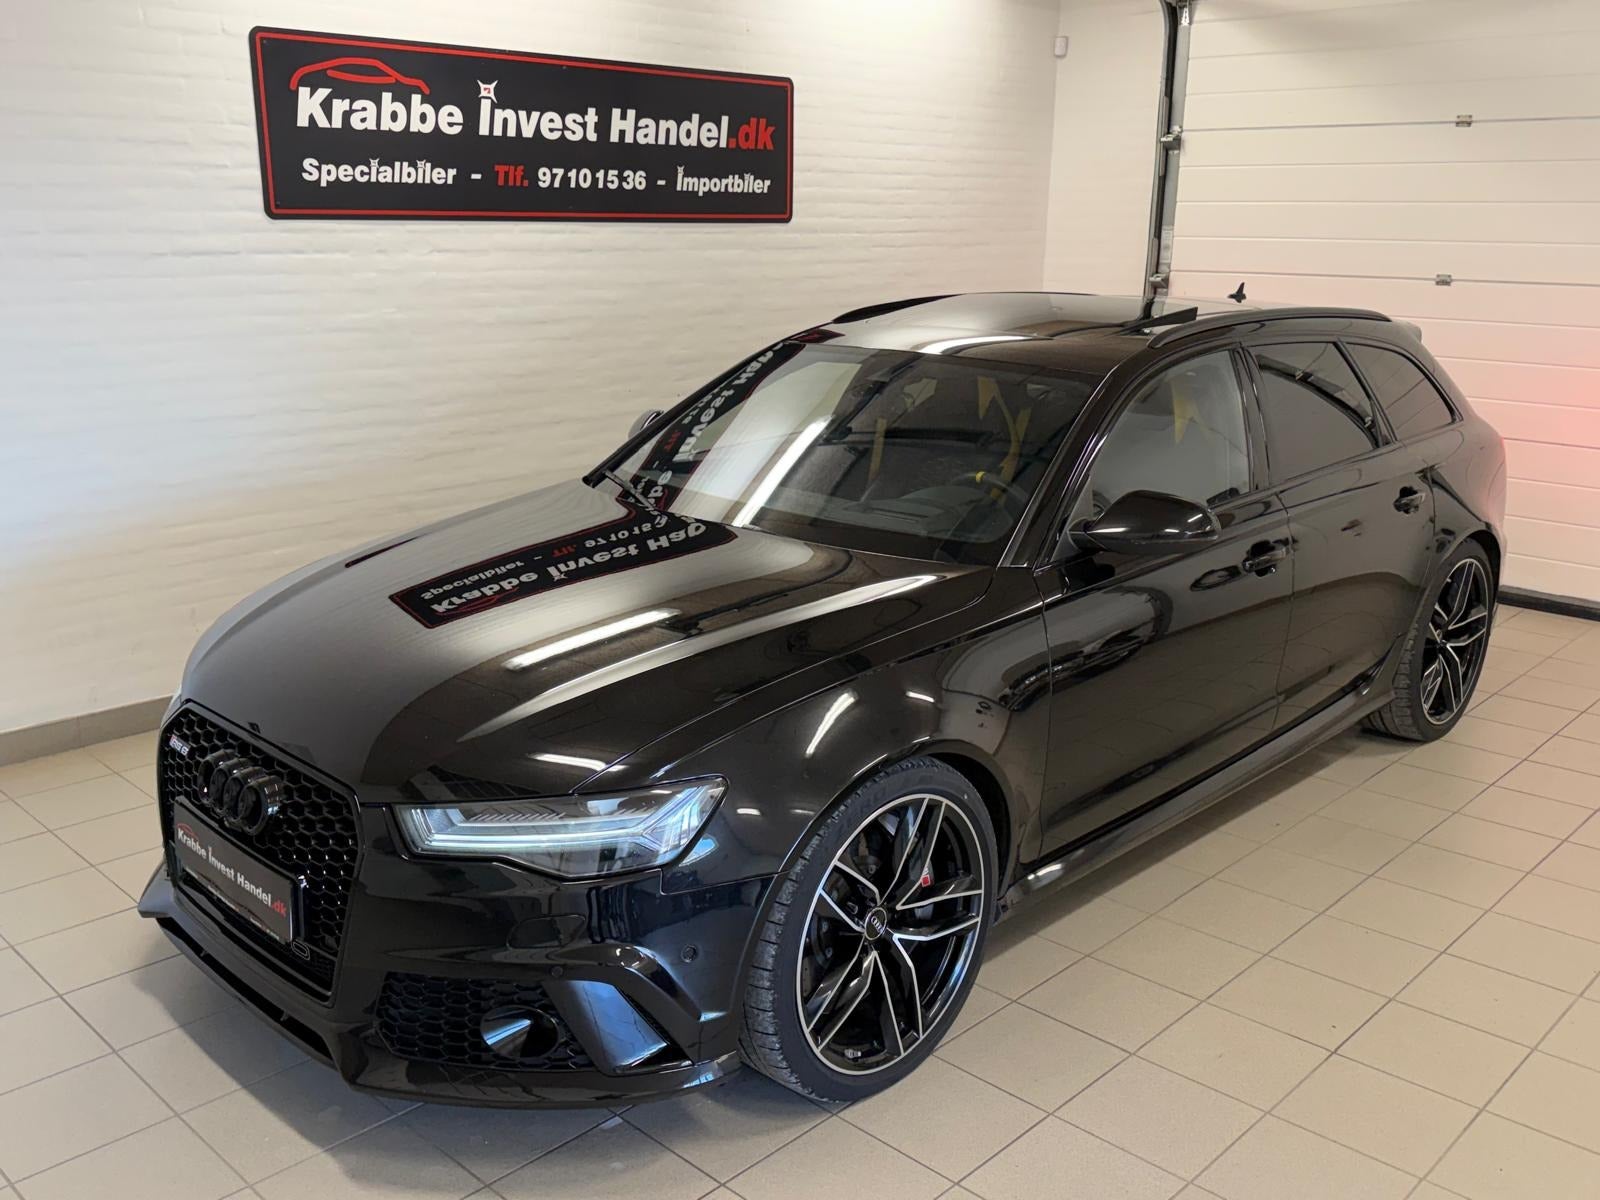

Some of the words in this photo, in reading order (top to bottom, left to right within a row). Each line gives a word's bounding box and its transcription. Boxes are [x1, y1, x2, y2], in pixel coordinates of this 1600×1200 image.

[297, 86, 463, 135] Krabbe
[477, 81, 598, 142] Invest
[609, 107, 776, 150] Handel.dk
[301, 158, 457, 187] Specialbiler
[494, 164, 529, 187] Tlf.
[537, 167, 647, 190] 97101536
[676, 165, 771, 196] Importbiler
[177, 827, 207, 860] Krabbe
[208, 845, 235, 881] Invest
[236, 871, 287, 919] Handel.dk
